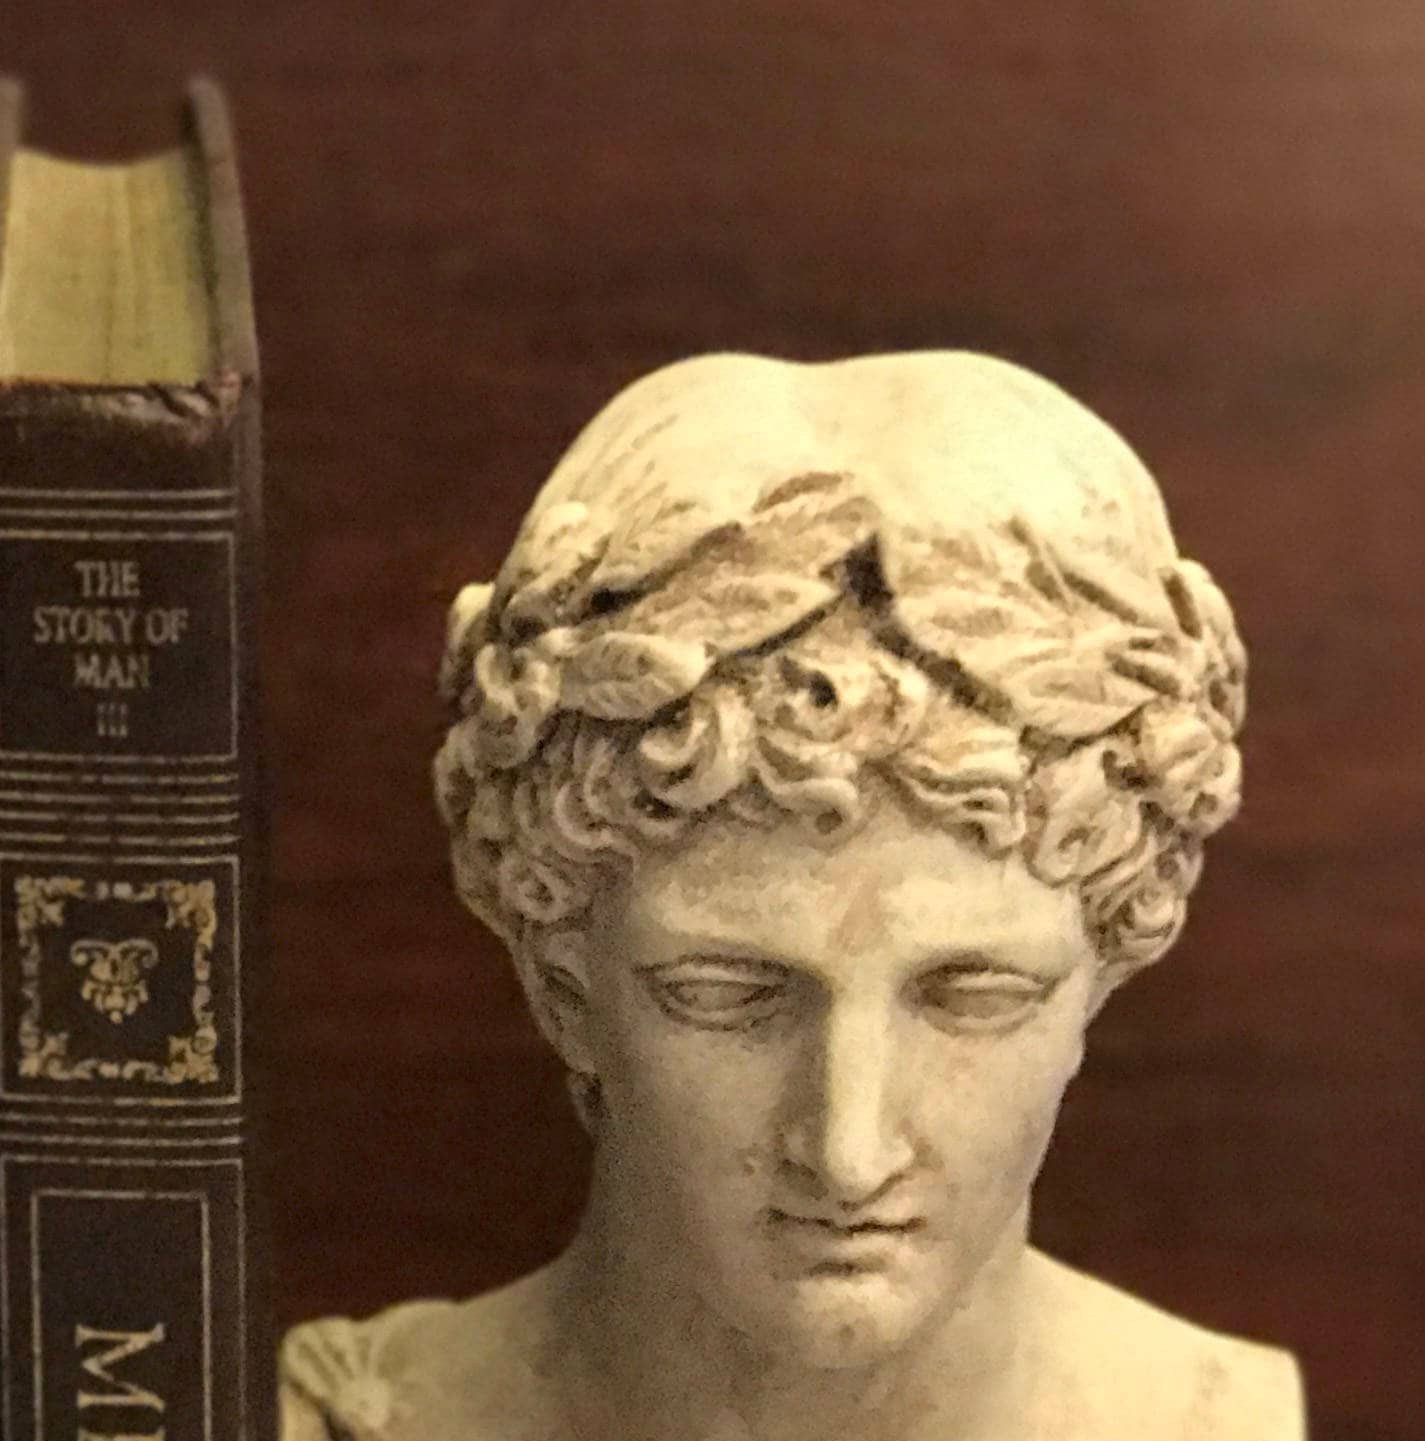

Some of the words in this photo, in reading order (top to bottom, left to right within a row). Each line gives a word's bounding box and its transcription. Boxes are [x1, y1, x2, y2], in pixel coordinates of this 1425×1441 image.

[74, 561, 141, 597] THE
[34, 606, 136, 645] STORY
[145, 607, 190, 645] OF
[75, 653, 151, 689] MAN
